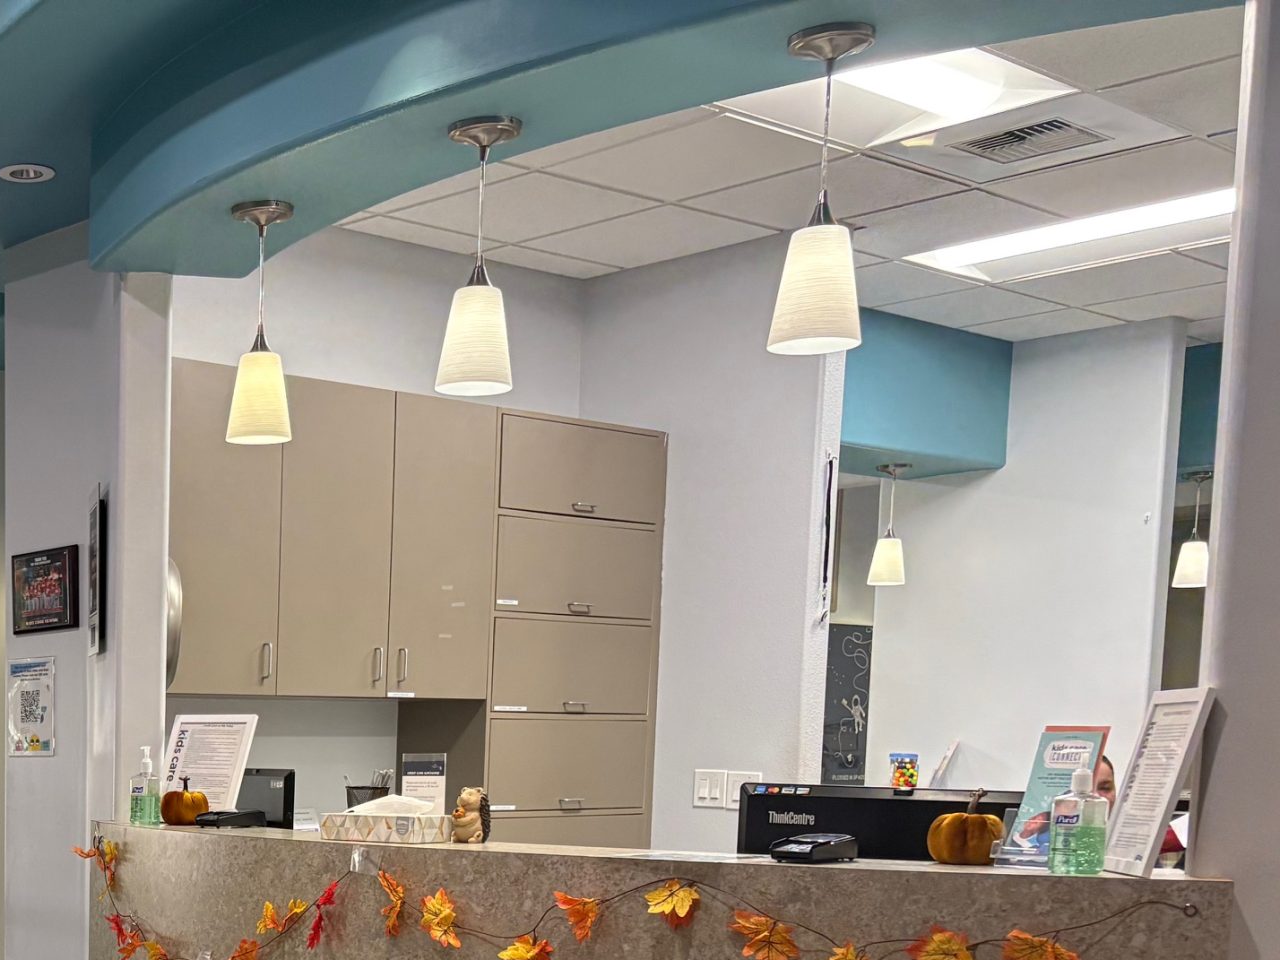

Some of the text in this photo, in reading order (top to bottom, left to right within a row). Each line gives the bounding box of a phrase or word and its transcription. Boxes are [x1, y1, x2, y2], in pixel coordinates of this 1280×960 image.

[167, 729, 188, 782] kids care
[768, 811, 815, 825] ThinkCentre
